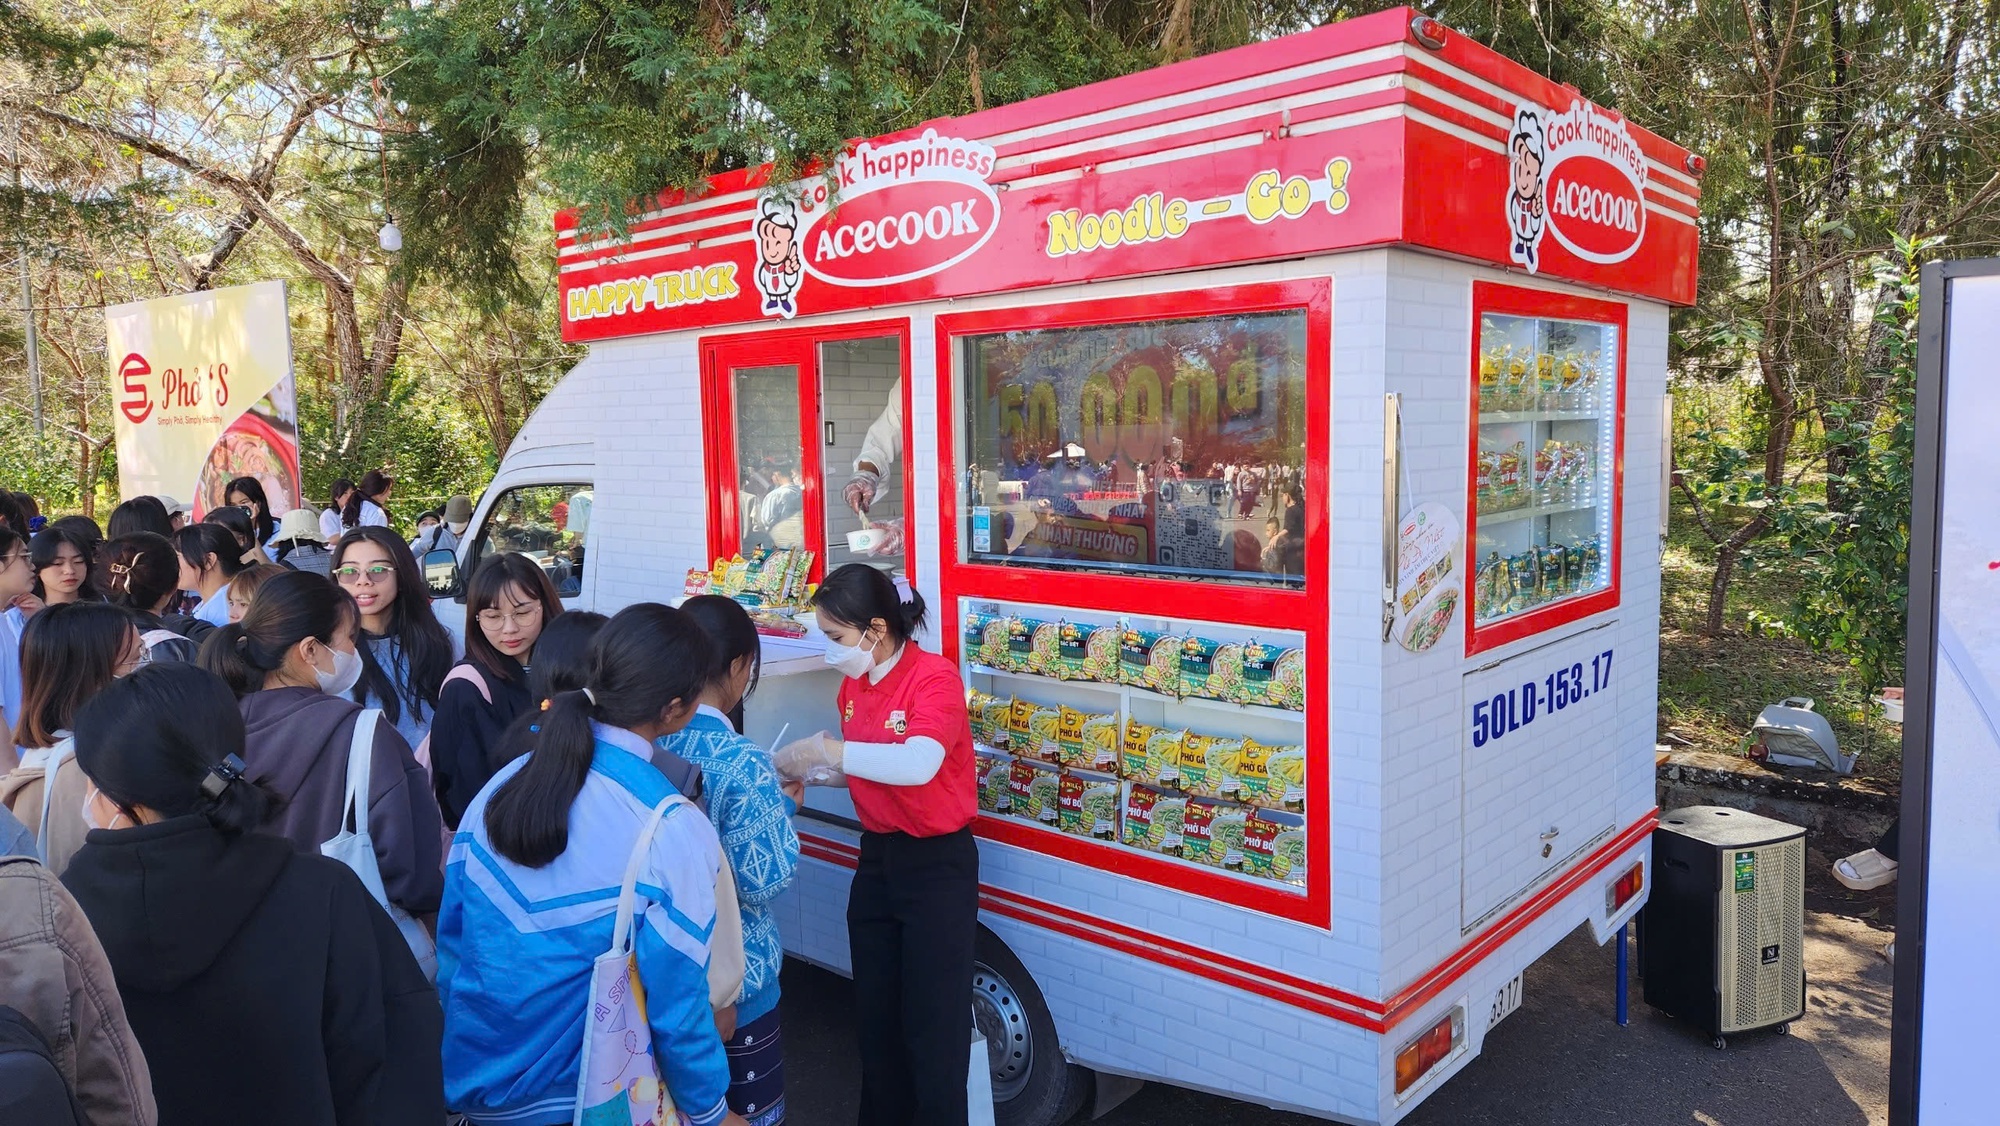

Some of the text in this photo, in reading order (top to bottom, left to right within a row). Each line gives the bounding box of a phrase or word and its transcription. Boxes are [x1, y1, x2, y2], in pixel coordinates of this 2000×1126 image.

[1547, 110, 1646, 184] Cook happiness
[863, 137, 992, 180] happiness
[1048, 195, 1187, 255] Noodle
[569, 264, 739, 319] HAPPY TRUCK
[162, 367, 203, 410] Phở
[1473, 650, 1613, 748] 50LD-153.17
[1060, 726, 1083, 739] PHỞ GÀ
[1181, 751, 1206, 765] PHỞ GÀ
[1256, 763, 1268, 775] GÀ
[1022, 783, 1031, 794] BÒ
[1072, 797, 1082, 808] BÒ
[1142, 808, 1152, 821] BÒ
[1200, 824, 1211, 837] BÒ
[1244, 835, 1274, 852] PHỞ BÒ
